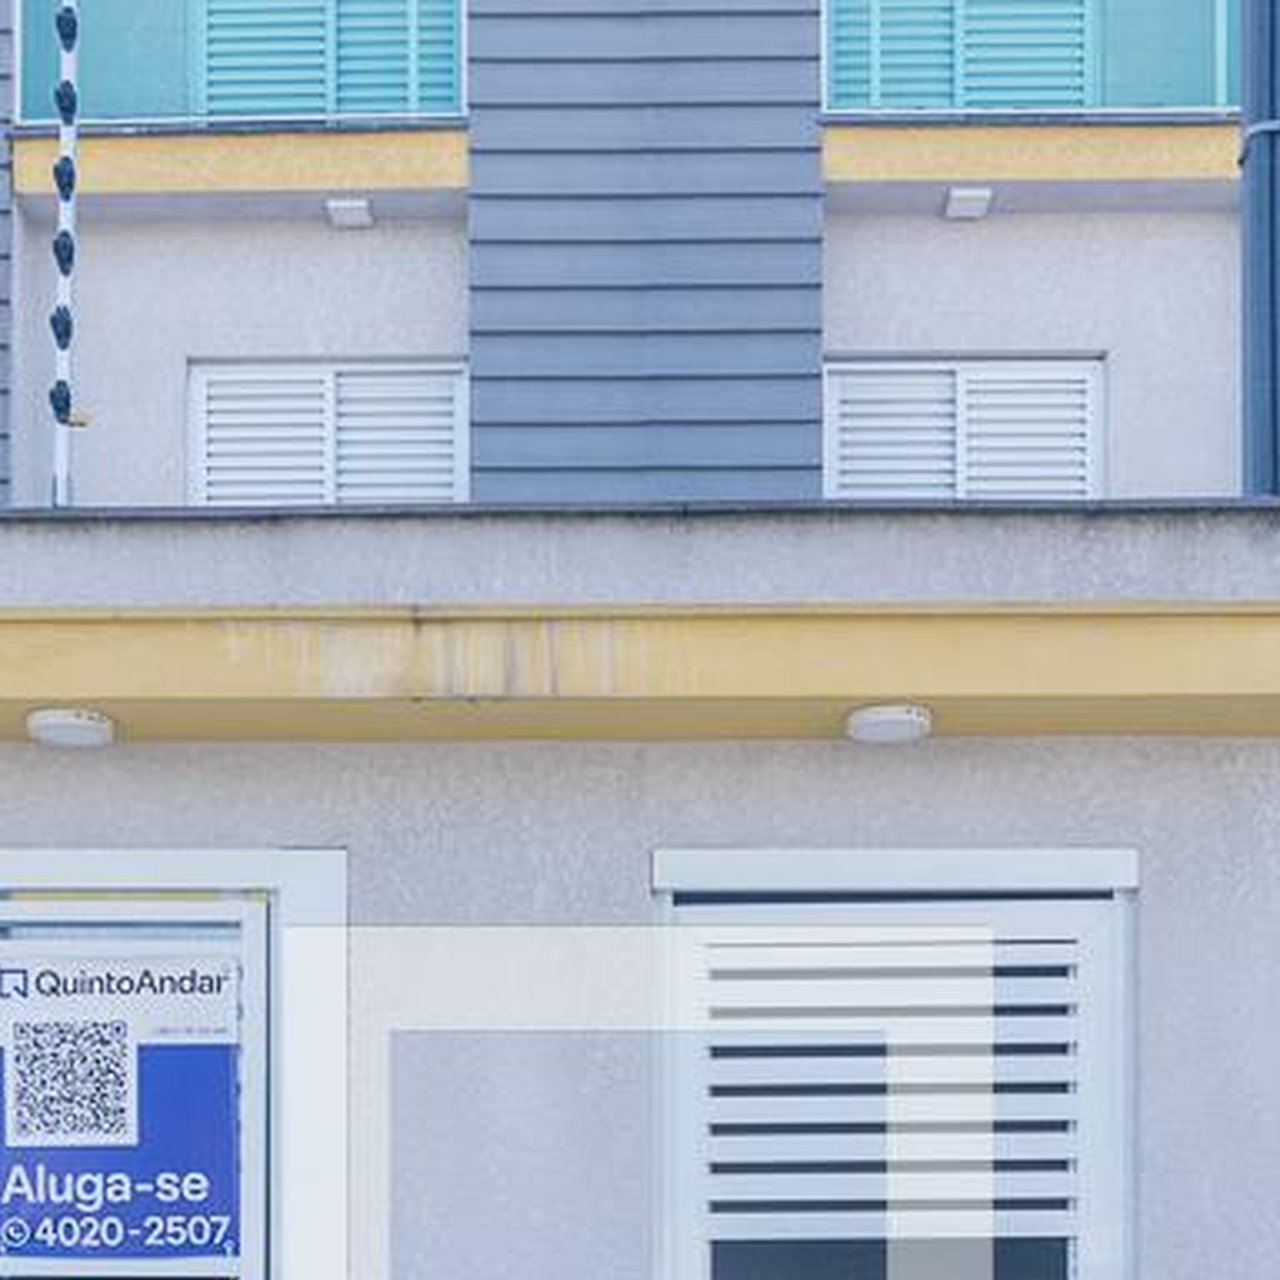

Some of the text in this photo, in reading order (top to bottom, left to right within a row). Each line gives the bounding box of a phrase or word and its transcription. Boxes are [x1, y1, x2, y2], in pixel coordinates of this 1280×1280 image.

[35, 968, 229, 998] QuintoAndar
[1, 1163, 210, 1213] Aluga-se
[34, 1215, 231, 1248] 4020-2507
